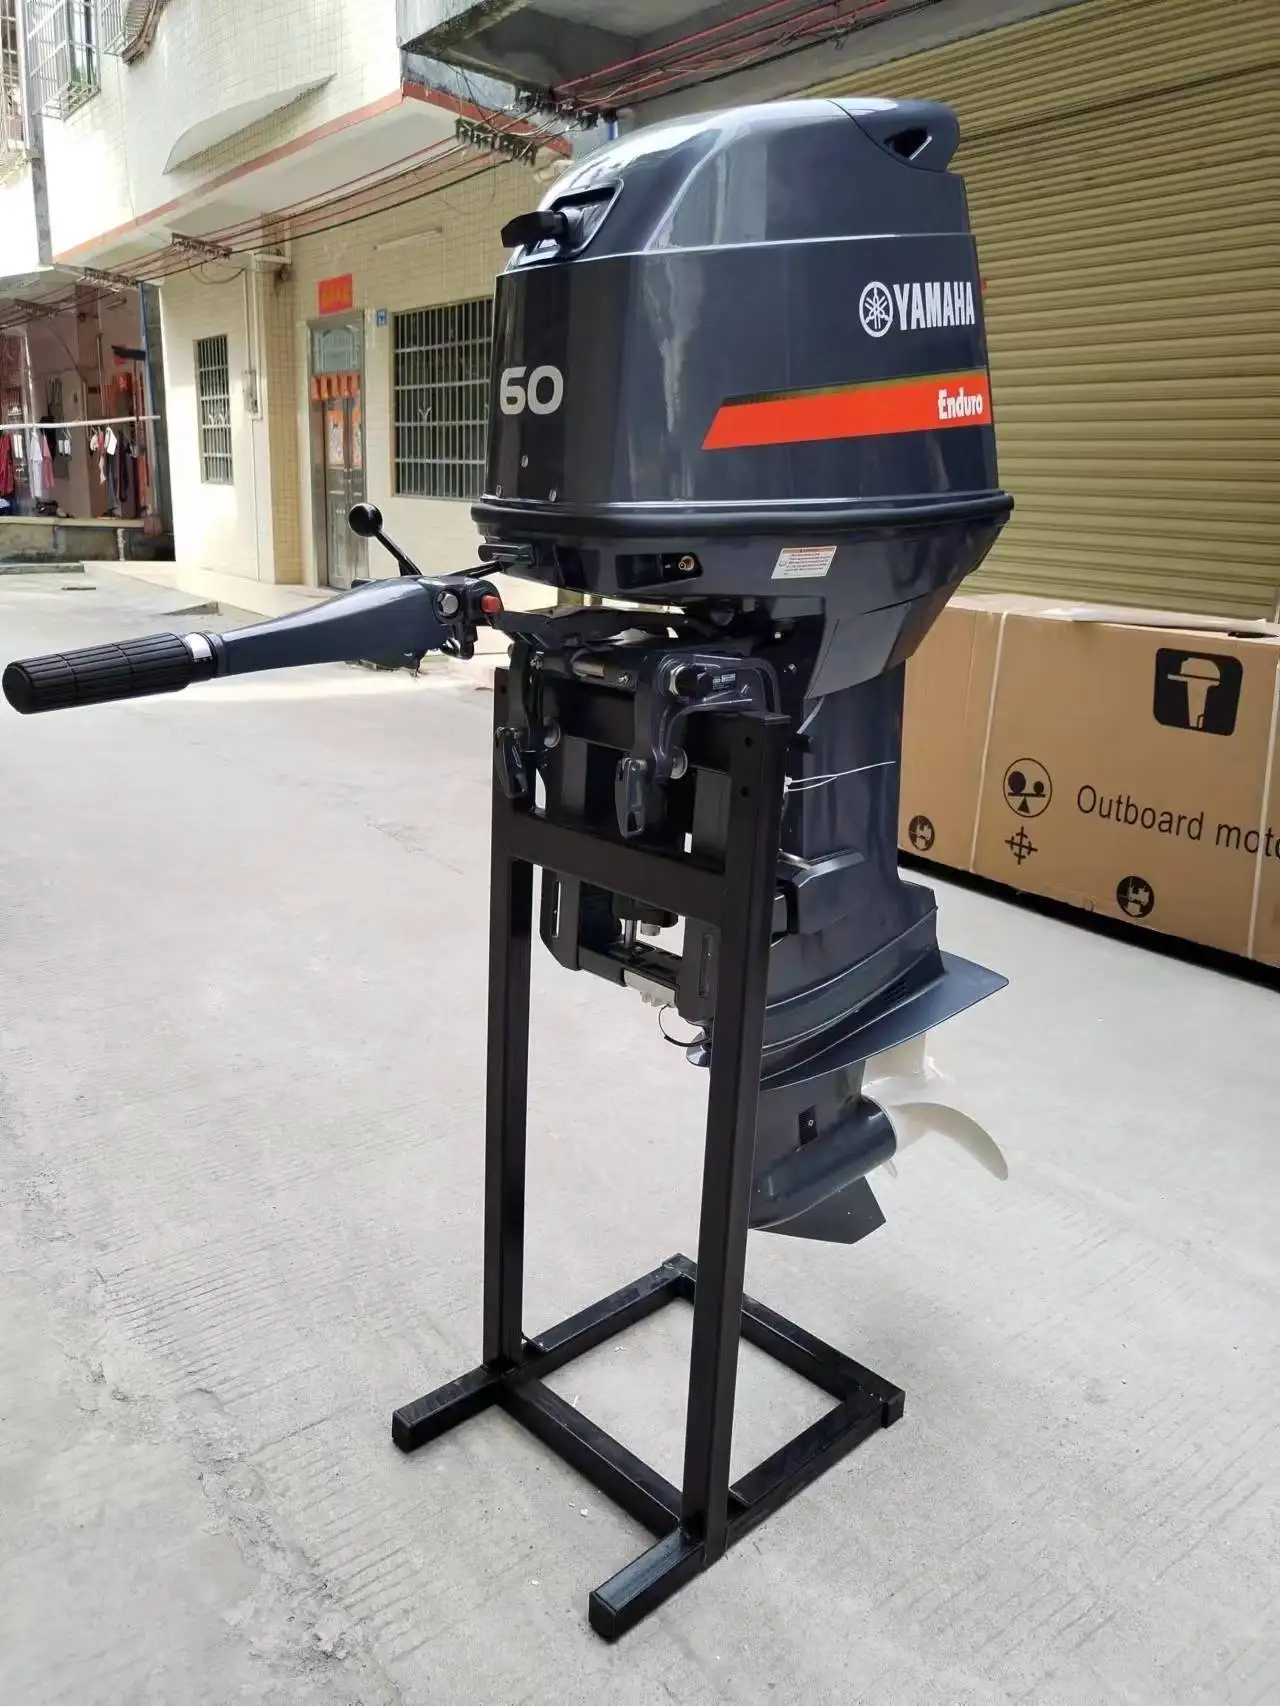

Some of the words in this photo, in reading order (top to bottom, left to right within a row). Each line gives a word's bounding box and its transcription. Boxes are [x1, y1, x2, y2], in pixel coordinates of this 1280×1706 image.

[893, 281, 976, 331] YAMAHA
[500, 365, 564, 415] 60
[938, 387, 983, 420] Enduro
[1077, 785, 1204, 841] Outboard
